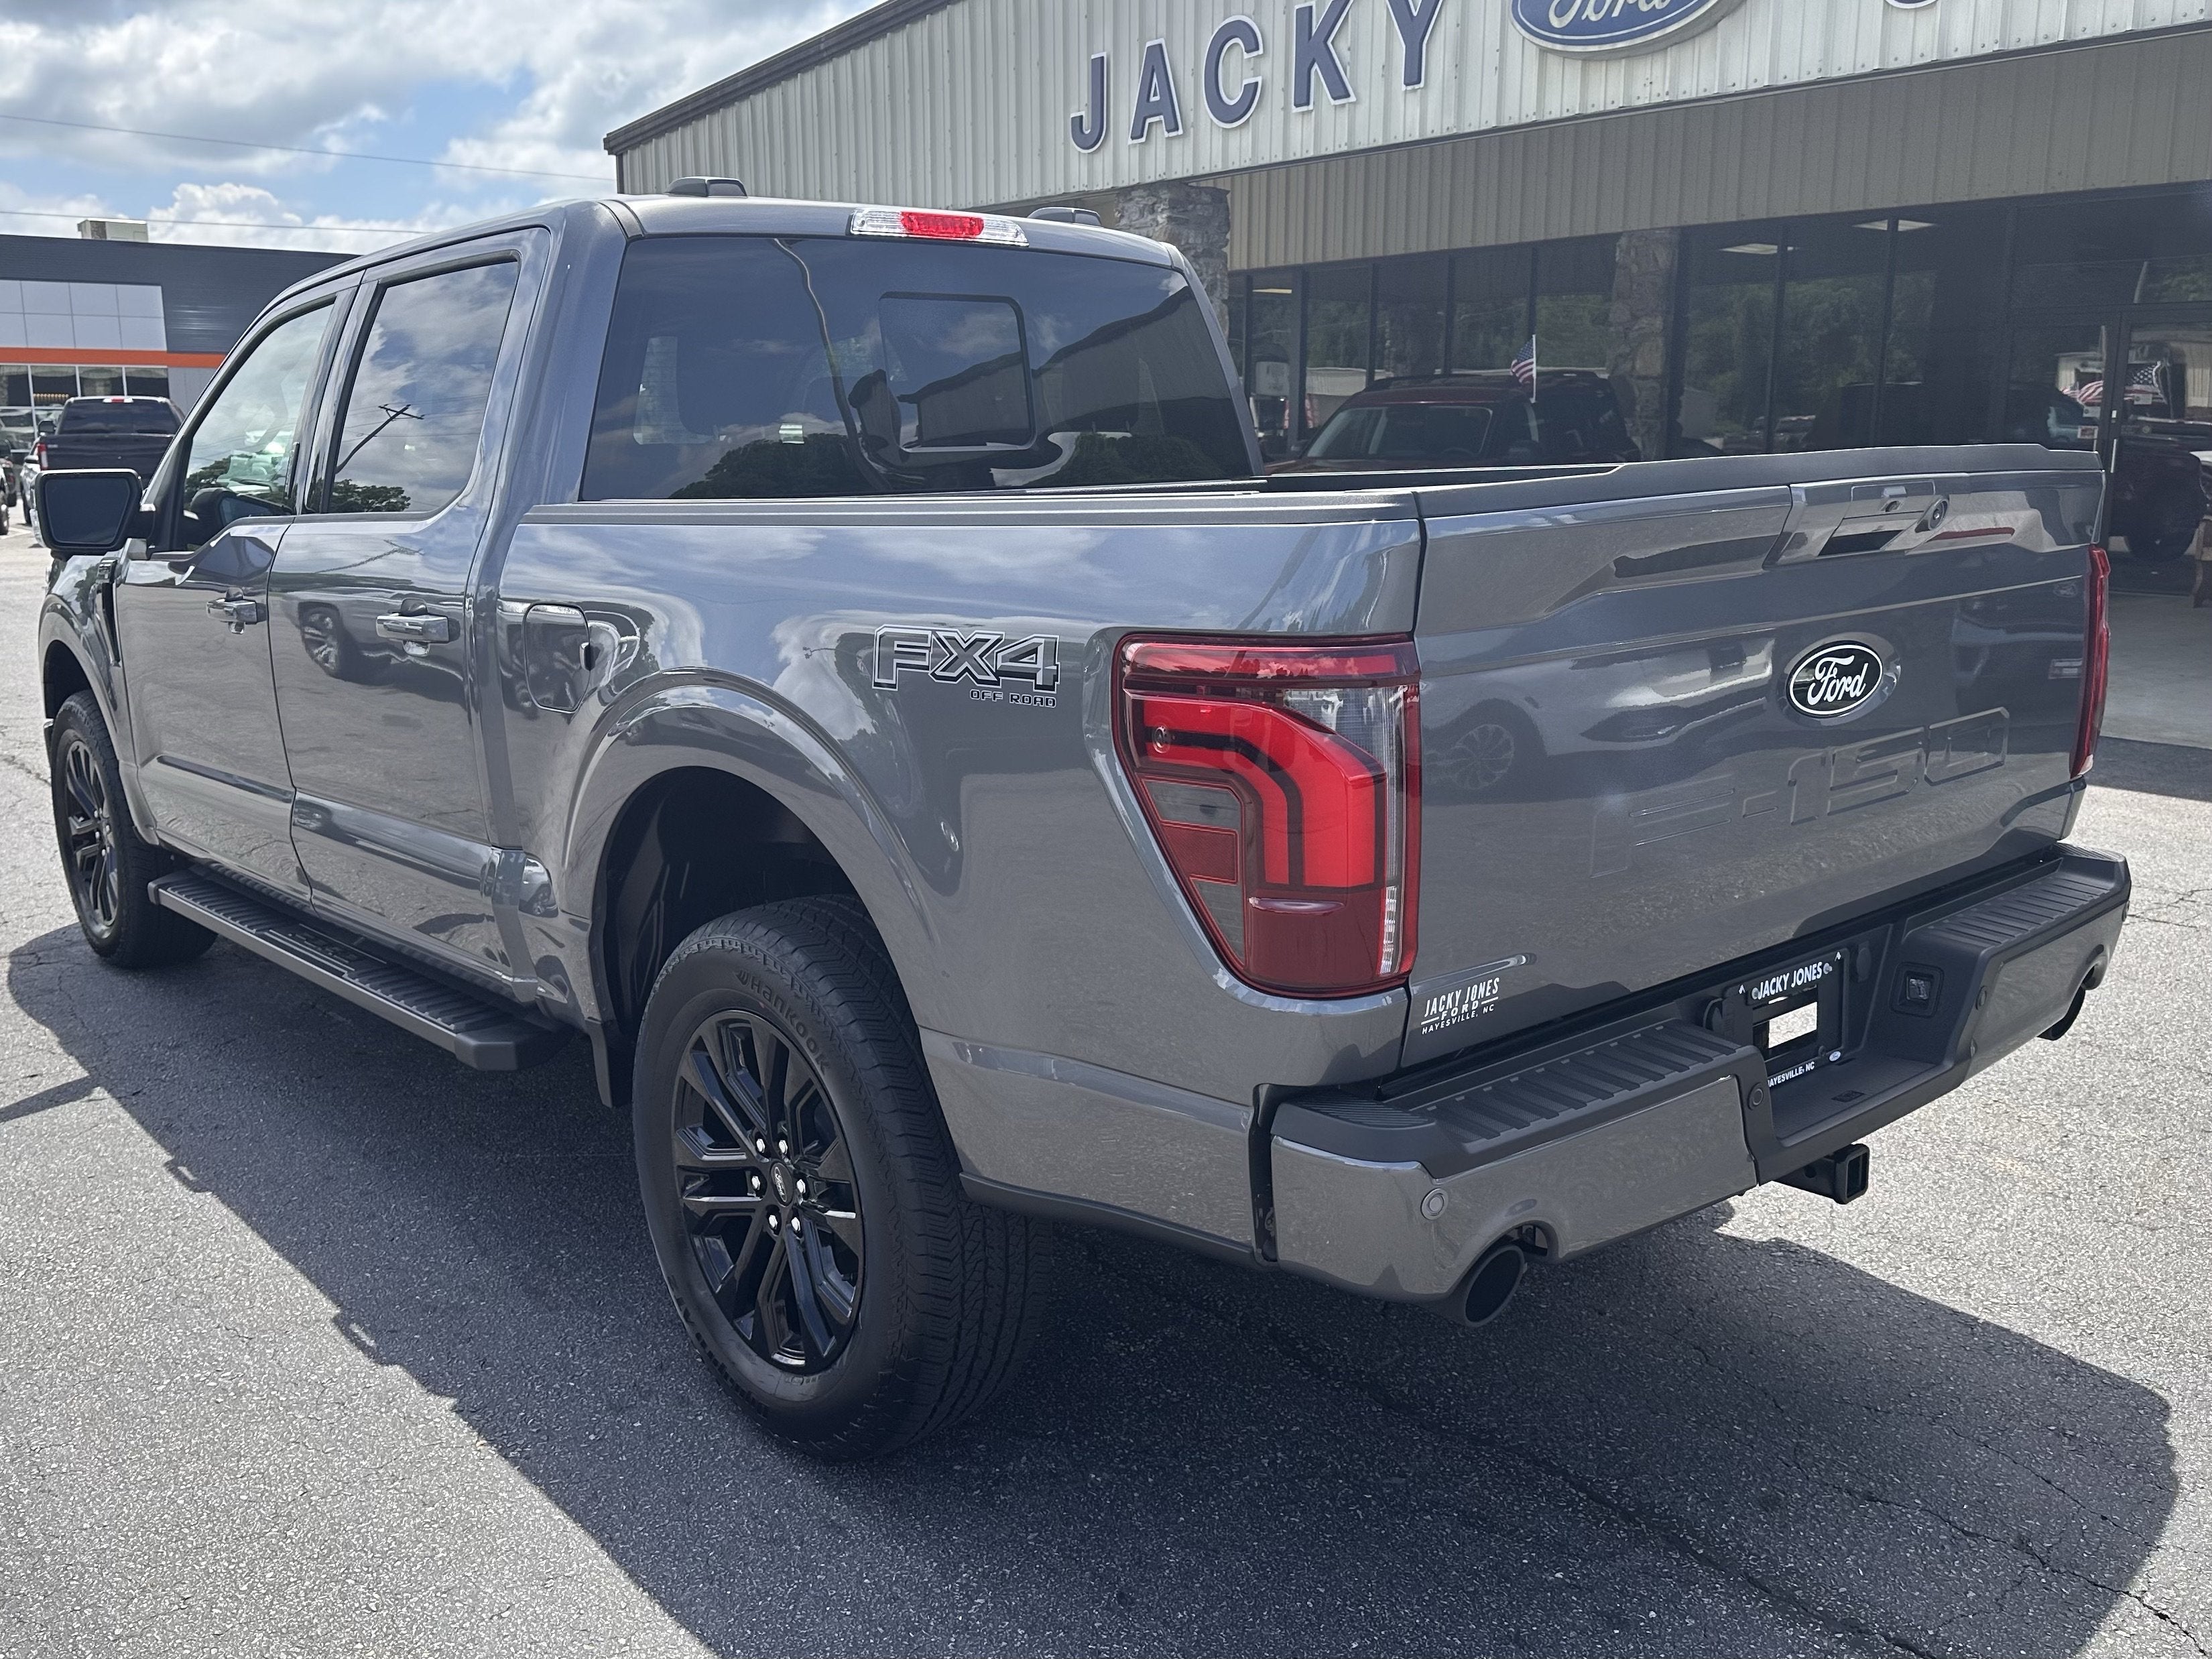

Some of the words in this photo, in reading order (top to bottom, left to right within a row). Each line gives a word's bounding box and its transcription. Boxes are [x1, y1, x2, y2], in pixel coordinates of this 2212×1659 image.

[1070, 0, 1442, 153] JACKY
[872, 623, 1061, 693] FX4
[970, 689, 1003, 701] OFF
[1009, 692, 1057, 708] ROAD
[1807, 654, 1869, 706] Ford
[1590, 706, 2010, 879] F-150
[1424, 988, 1461, 1018] JACKY
[1465, 977, 1500, 1005] JONES
[1758, 973, 1790, 999] JACKY
[1791, 961, 1823, 988] JONES
[1422, 1011, 1479, 1035] HAYESVILLE,
[1483, 1003, 1495, 1013] NC
[1440, 1000, 1479, 1021] FORD
[1805, 1061, 1815, 1071] NC
